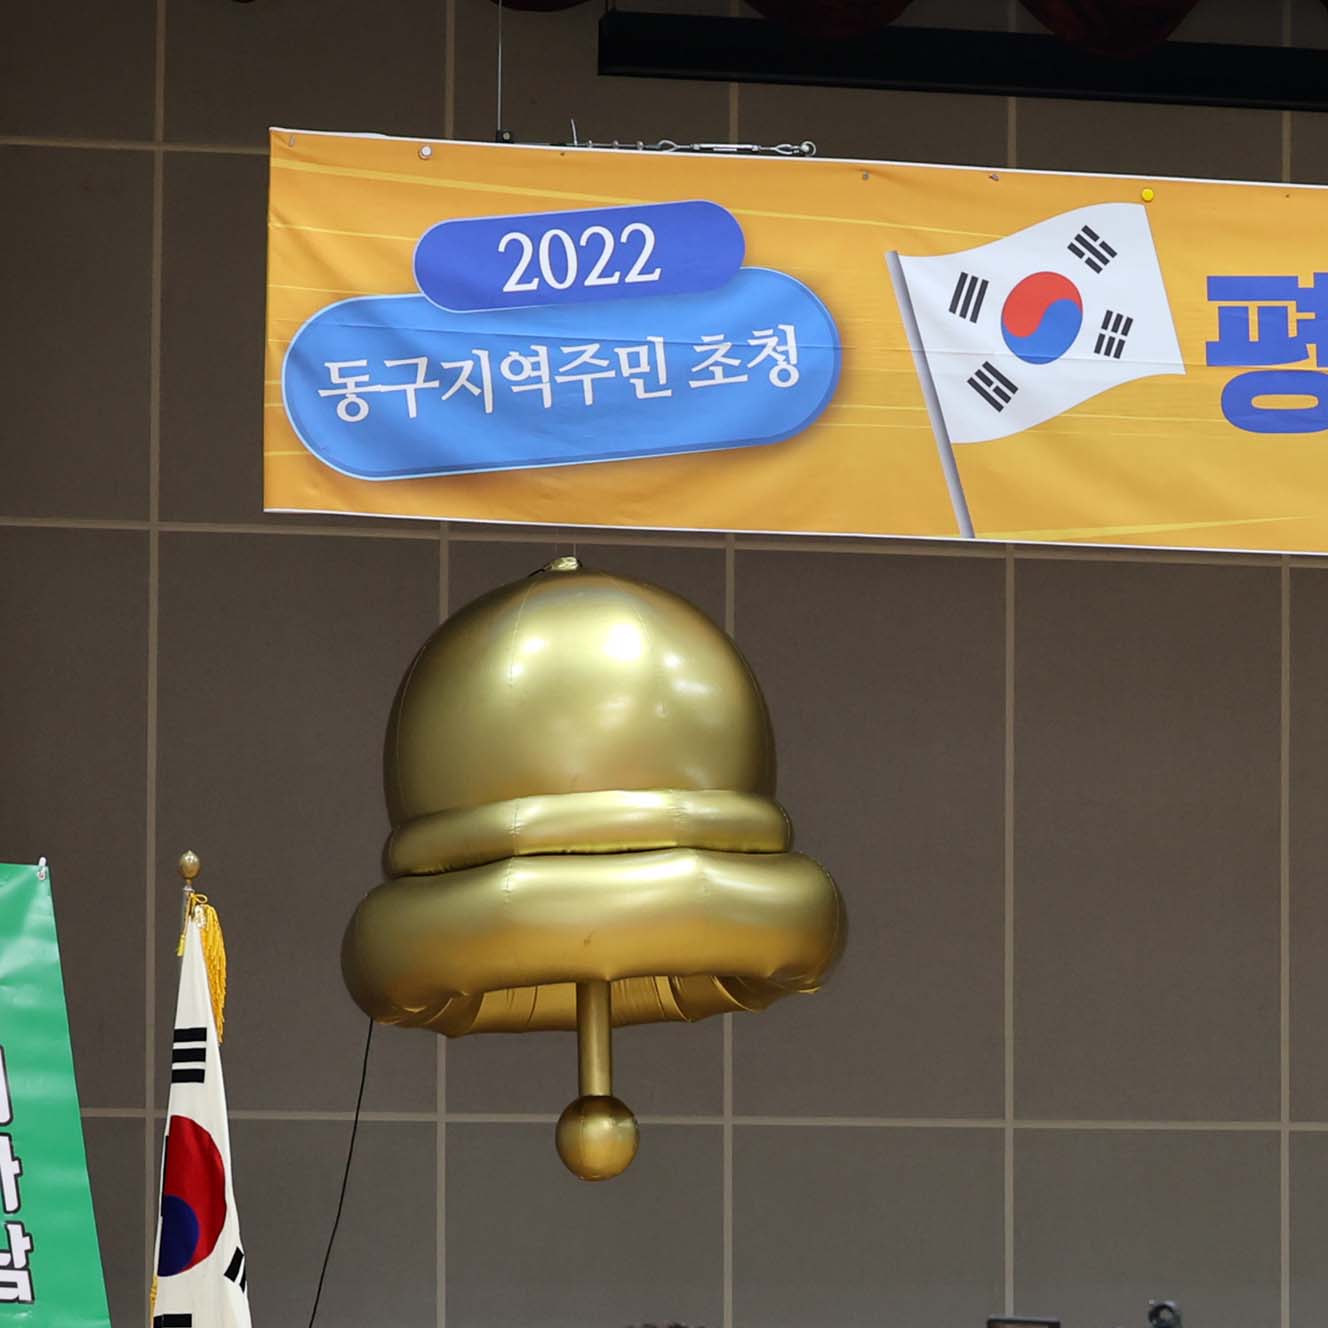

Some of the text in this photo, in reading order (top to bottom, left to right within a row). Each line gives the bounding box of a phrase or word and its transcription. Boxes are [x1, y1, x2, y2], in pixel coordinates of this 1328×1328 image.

[498, 222, 662, 293] 2022
[318, 325, 801, 423] 동구지역주민 초청
